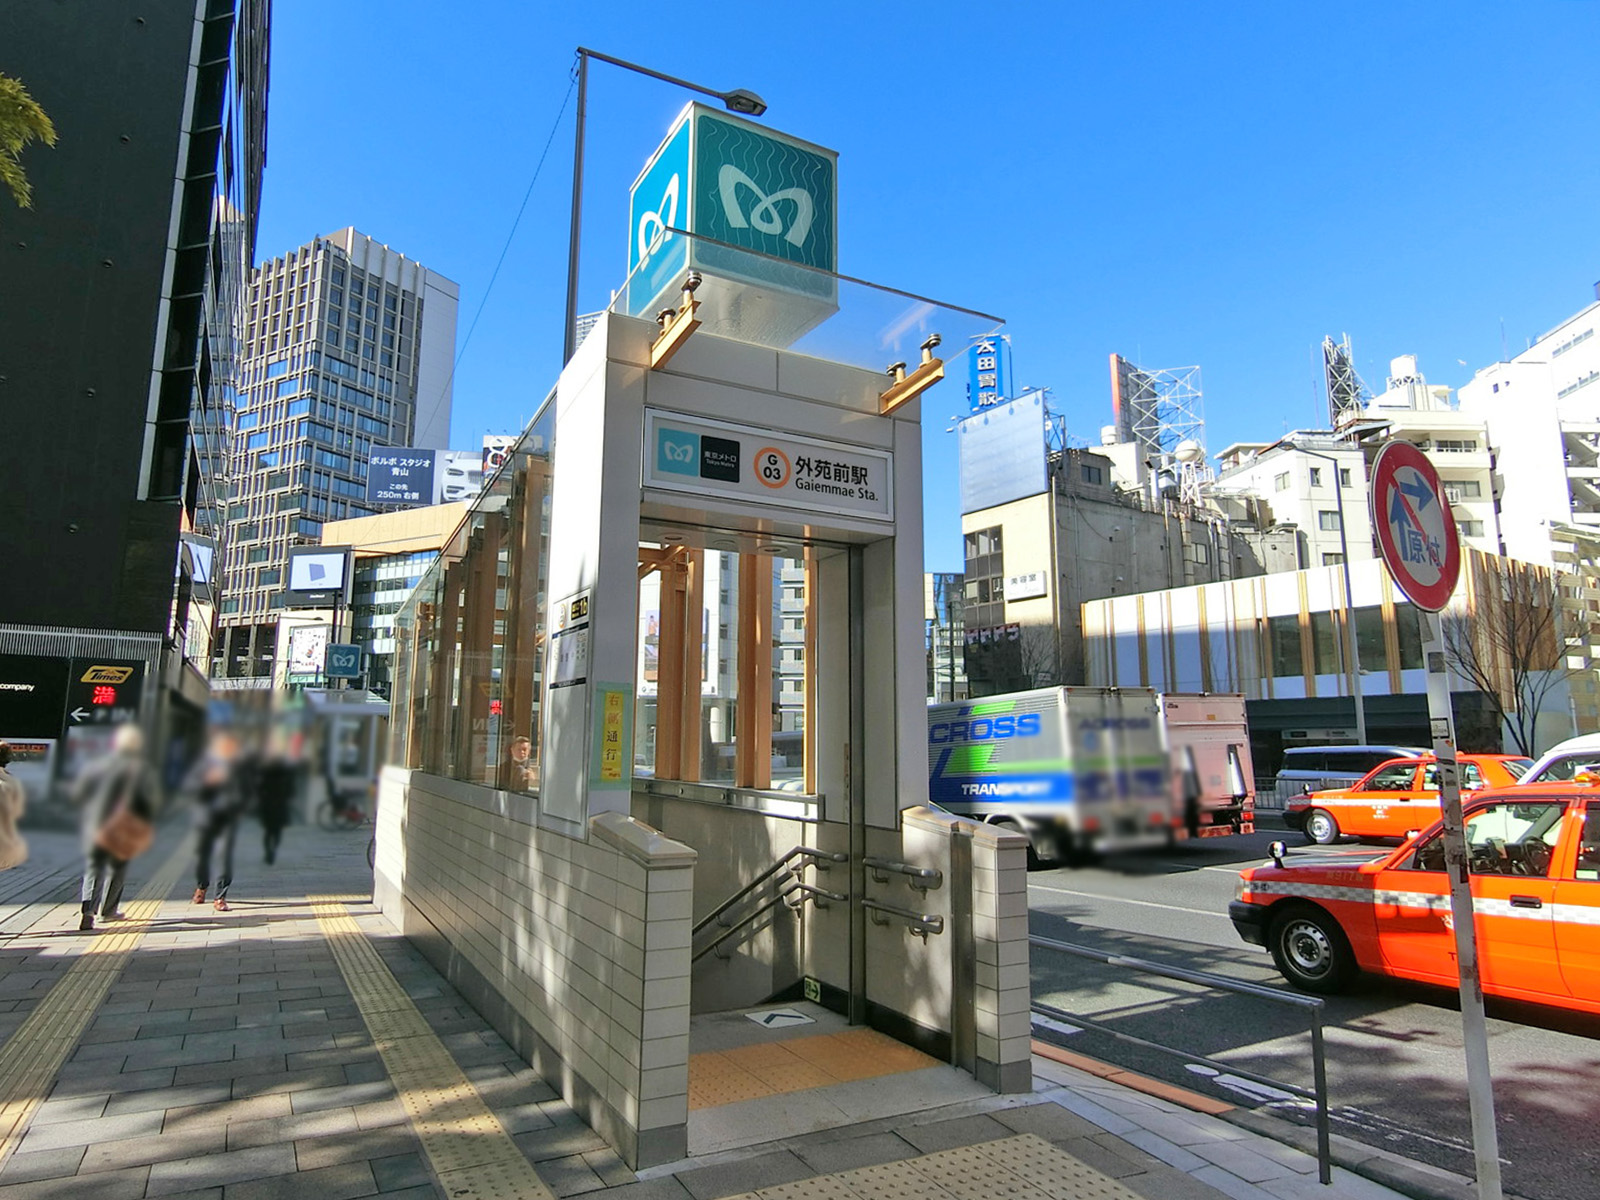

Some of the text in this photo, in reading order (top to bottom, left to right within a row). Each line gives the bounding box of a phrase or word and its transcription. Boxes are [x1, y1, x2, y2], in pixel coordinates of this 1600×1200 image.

[400, 458, 431, 468] スタジオ
[767, 454, 778, 466] G
[763, 467, 781, 480] 03
[795, 455, 868, 486] 外苑前駅
[377, 490, 402, 499] 250m
[795, 477, 879, 501] Gaiemmae Sta.
[1408, 529, 1442, 567] 原付
[90, 671, 124, 682] Times
